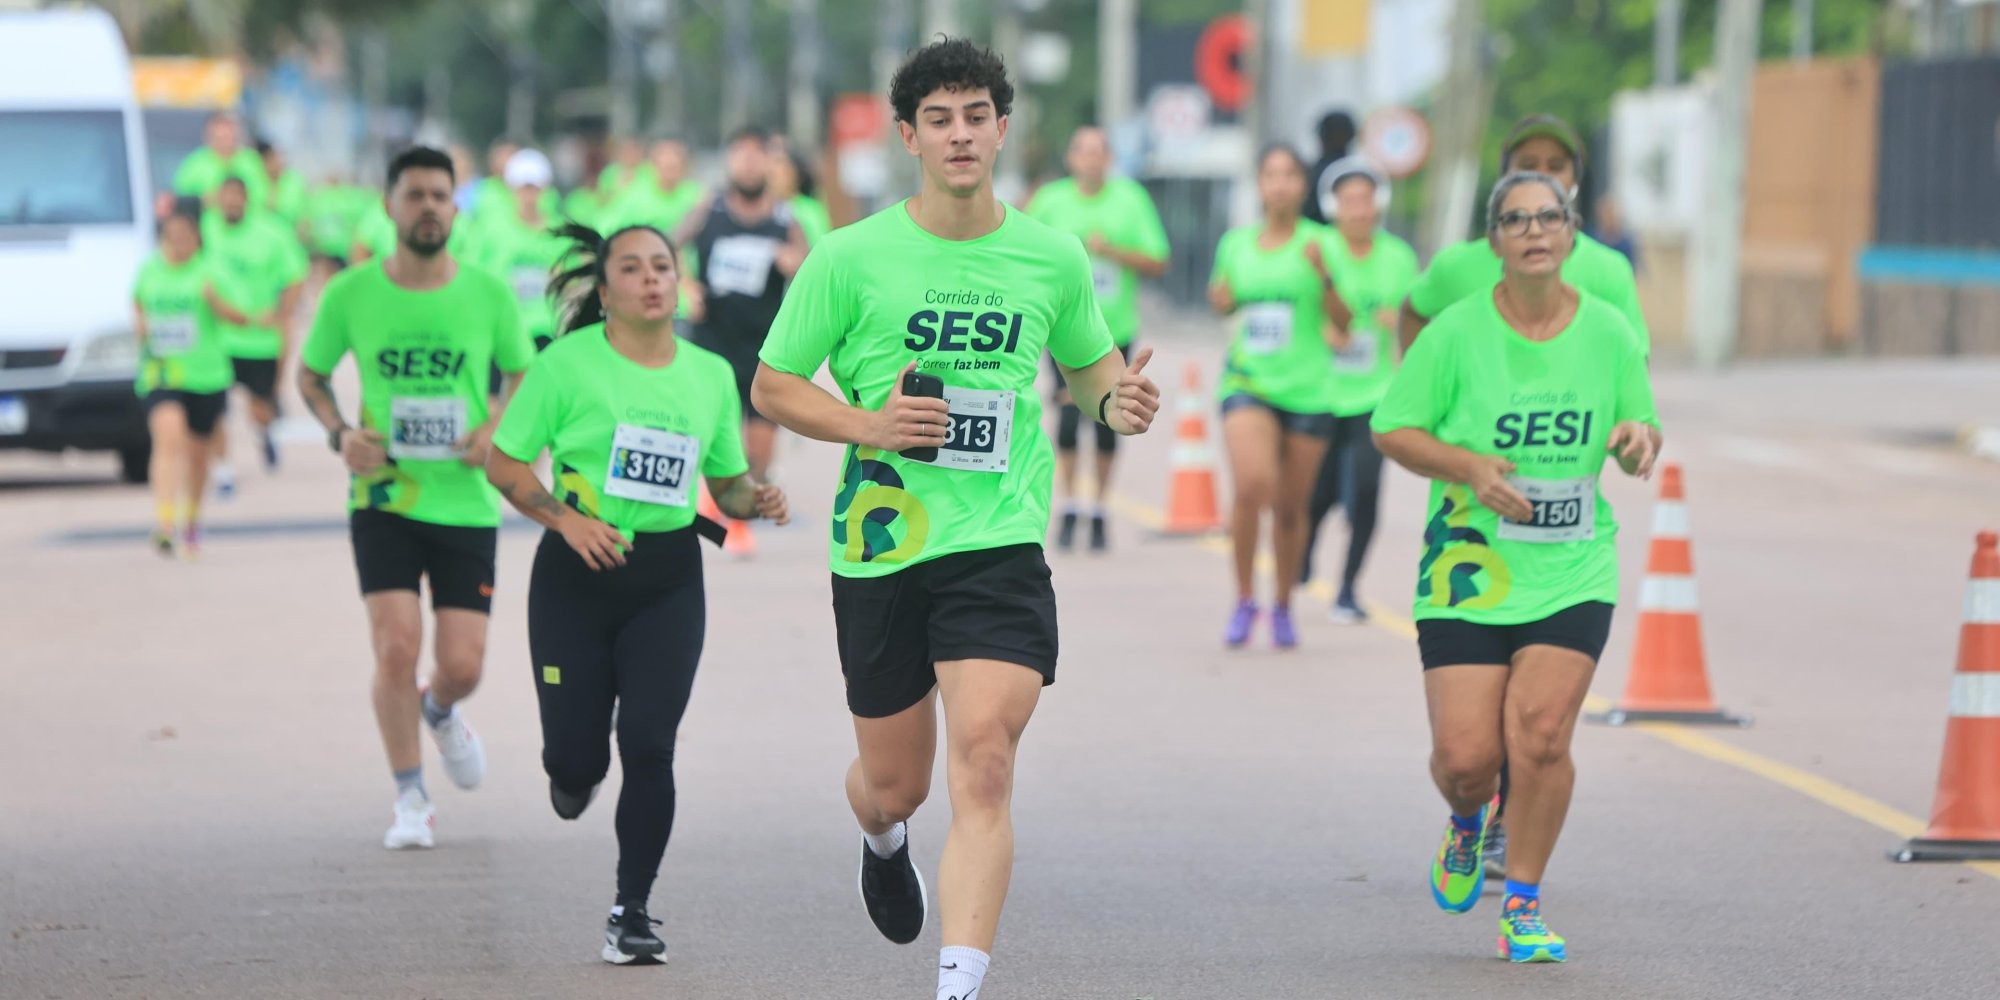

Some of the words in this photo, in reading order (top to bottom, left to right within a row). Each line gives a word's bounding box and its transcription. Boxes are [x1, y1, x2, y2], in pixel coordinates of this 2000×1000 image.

[925, 289, 980, 305] Corrida
[984, 290, 1004, 307] do
[904, 310, 1023, 353] SESI
[378, 348, 466, 379] SESI
[916, 357, 951, 369] Correr
[953, 358, 973, 370] faz
[974, 358, 1001, 370] bem
[943, 416, 992, 448] 313
[1493, 411, 1593, 450] SESI
[626, 451, 682, 486] 3194
[1534, 501, 1579, 525] 150
